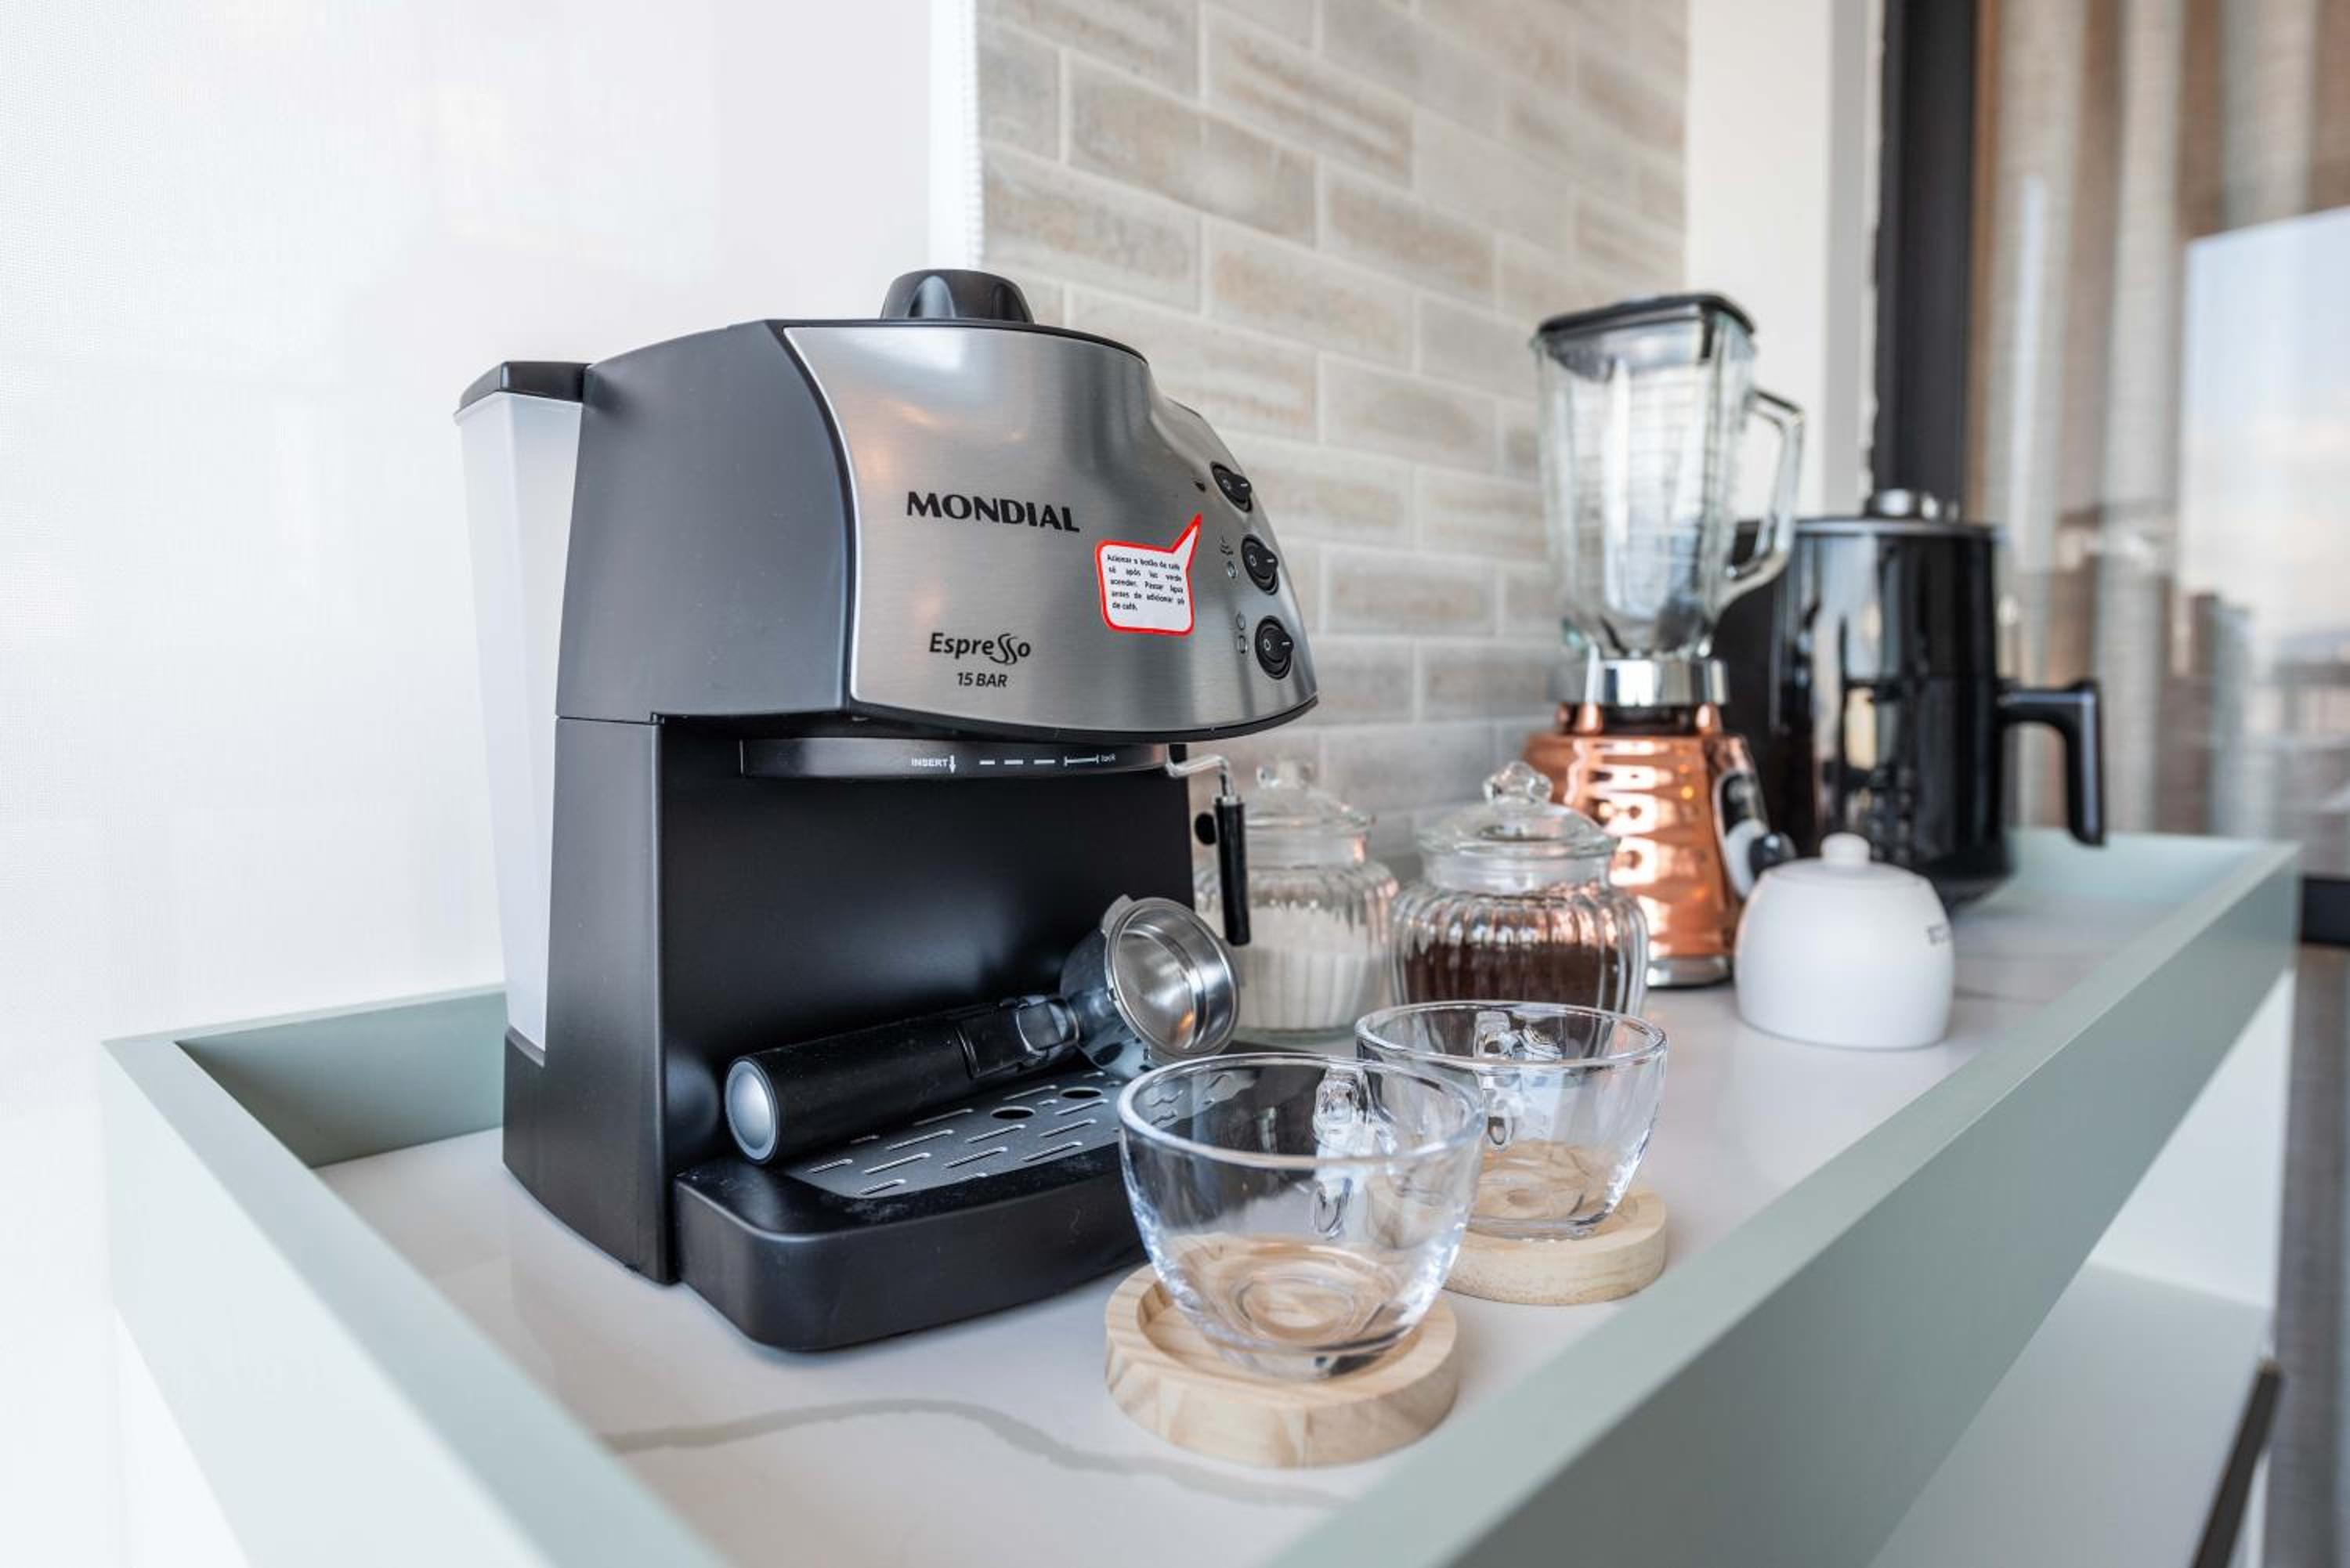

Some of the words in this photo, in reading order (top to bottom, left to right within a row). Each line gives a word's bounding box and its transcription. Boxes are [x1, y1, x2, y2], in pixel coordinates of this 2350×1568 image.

[906, 491, 1080, 533] MONDIAL
[929, 632, 1032, 666] Espresso
[956, 671, 974, 687] 15
[975, 673, 1008, 688] BAR
[911, 757, 948, 768] INSERT
